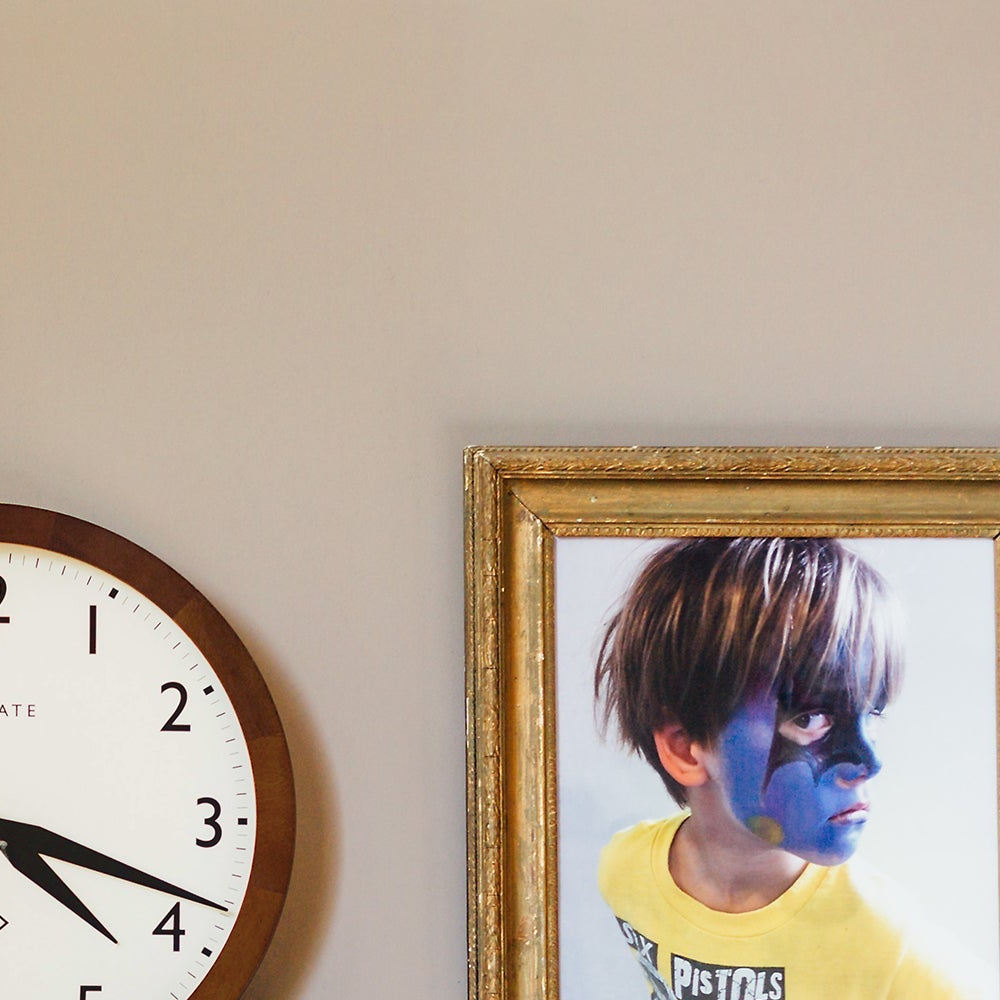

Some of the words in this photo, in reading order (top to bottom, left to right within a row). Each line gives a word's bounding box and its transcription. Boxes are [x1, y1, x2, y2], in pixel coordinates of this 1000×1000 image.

[89, 604, 98, 655] 1
[160, 681, 191, 732] 2
[195, 796, 223, 848] 3
[152, 902, 186, 952] 4
